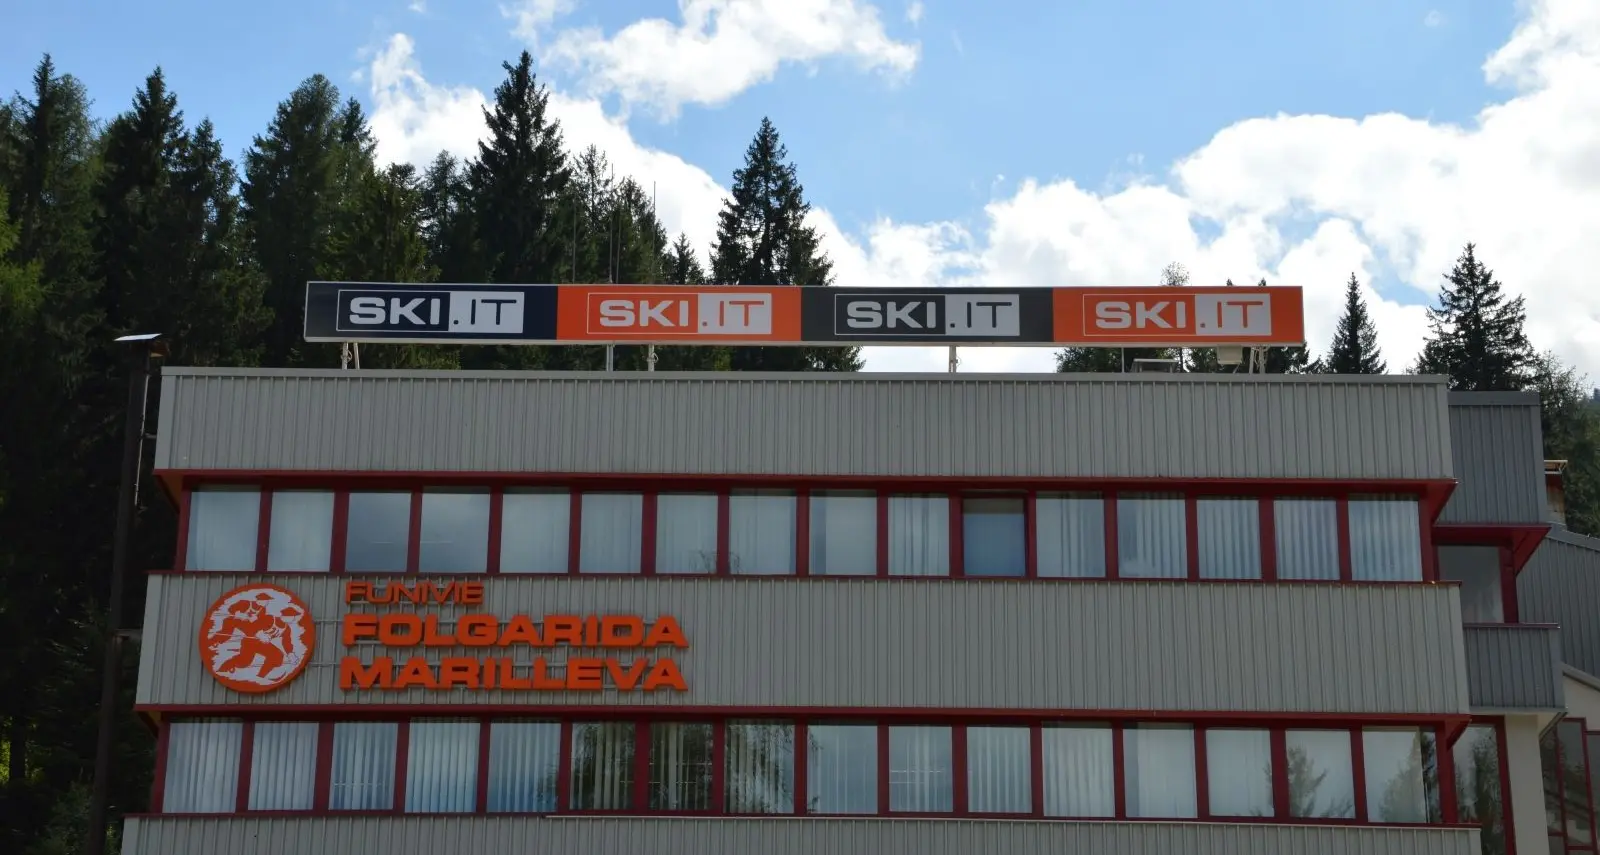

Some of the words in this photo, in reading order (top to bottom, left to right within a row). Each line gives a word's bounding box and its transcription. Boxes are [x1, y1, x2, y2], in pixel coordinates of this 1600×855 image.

[349, 297, 517, 325] SKI.IT
[600, 300, 765, 327] SKI.IT
[846, 301, 1013, 329] SKI.IT
[1095, 301, 1264, 329] SKI.IT
[345, 581, 484, 605] FUNIVIE
[342, 613, 689, 648] FOLGARIDA
[339, 657, 689, 691] MARILLEVA
